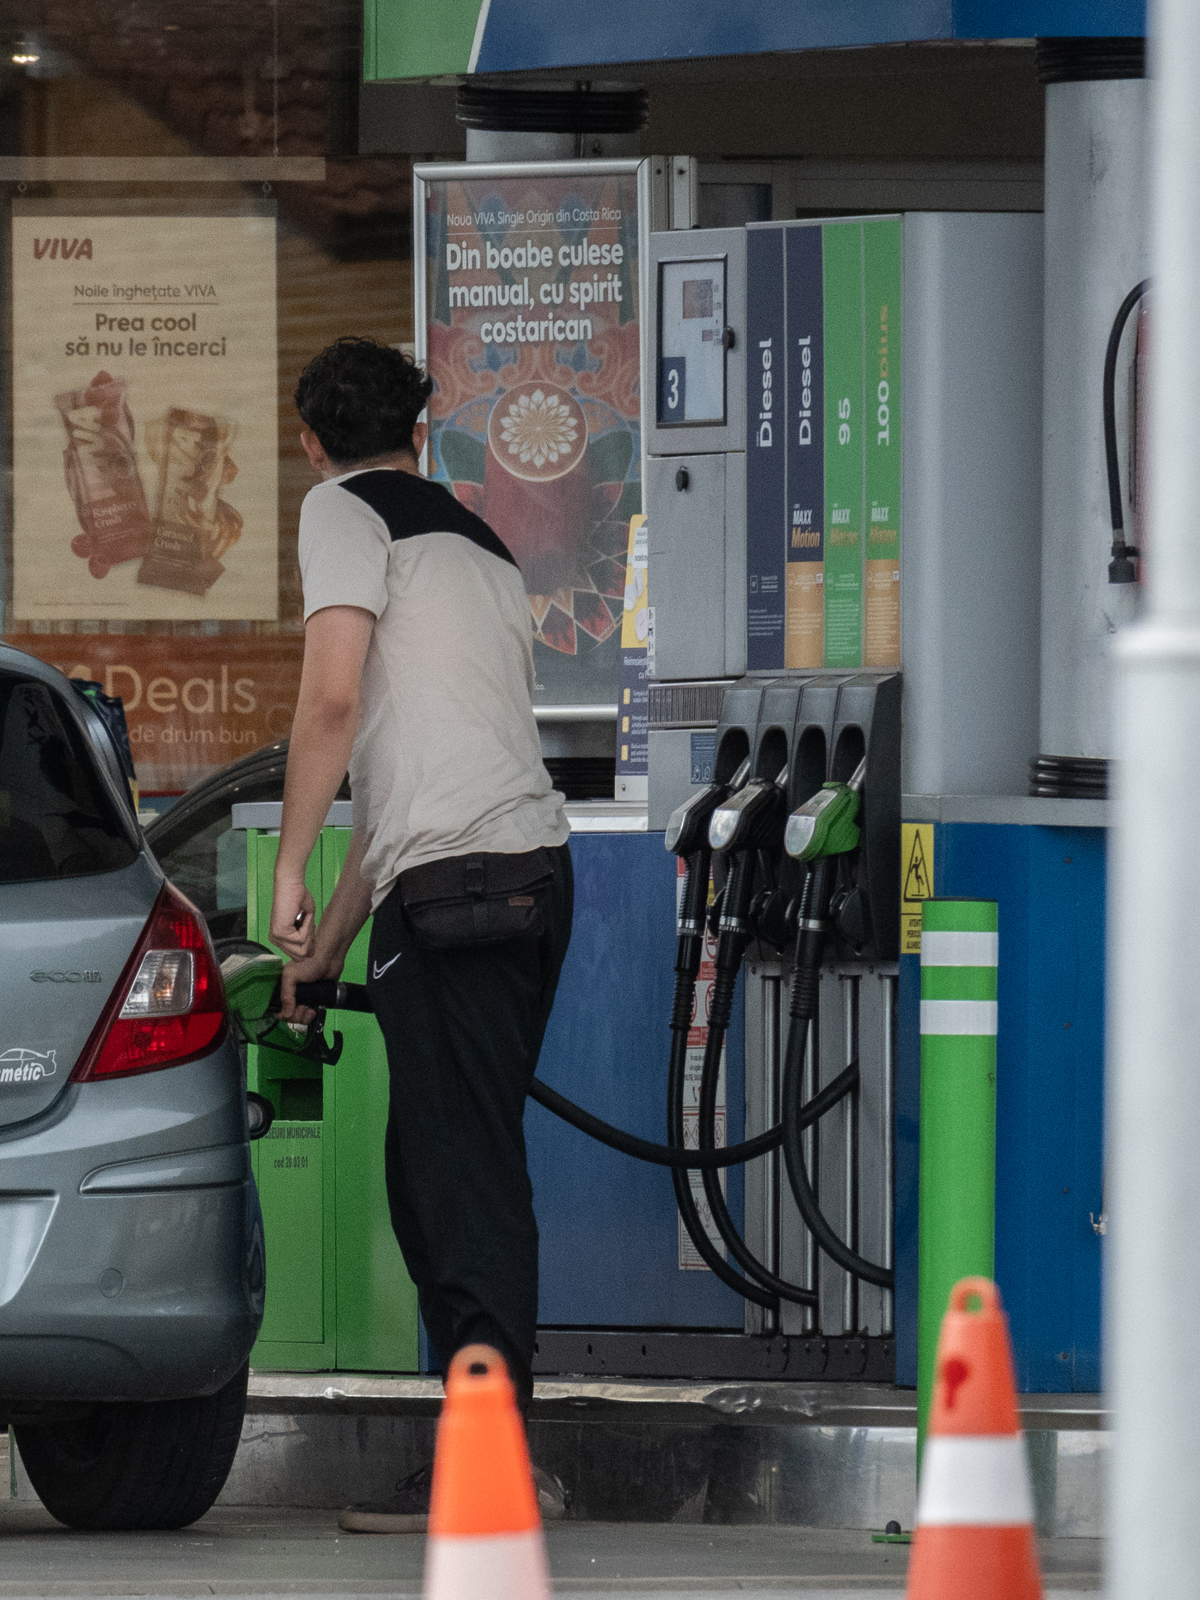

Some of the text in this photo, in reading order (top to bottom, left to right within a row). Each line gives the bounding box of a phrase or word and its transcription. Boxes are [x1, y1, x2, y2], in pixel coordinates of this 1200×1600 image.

[446, 206, 621, 228] Noua VIVA Single Origin din Costa Rica
[33, 237, 93, 260] VIVA
[446, 237, 624, 271] Din boabe culese
[74, 284, 109, 298] Noile
[184, 284, 216, 297] VIVA
[449, 273, 623, 311] manual, cu spirit
[95, 313, 197, 331] Prea cool
[480, 312, 592, 344] costarican
[65, 335, 227, 357] să nu le încerci
[667, 369, 679, 409] 3
[759, 337, 772, 447] Diesel
[798, 335, 811, 446] Diesel
[838, 397, 851, 446] 95
[793, 509, 813, 525] MAXX
[831, 508, 851, 525] MAXX
[871, 506, 889, 522] MAXX
[791, 527, 821, 548] Motion
[105, 664, 257, 714] Deals
[130, 725, 257, 744] de drum bun
[286, 1126, 321, 1139] MUNICIPALE
[273, 1155, 284, 1168] cod
